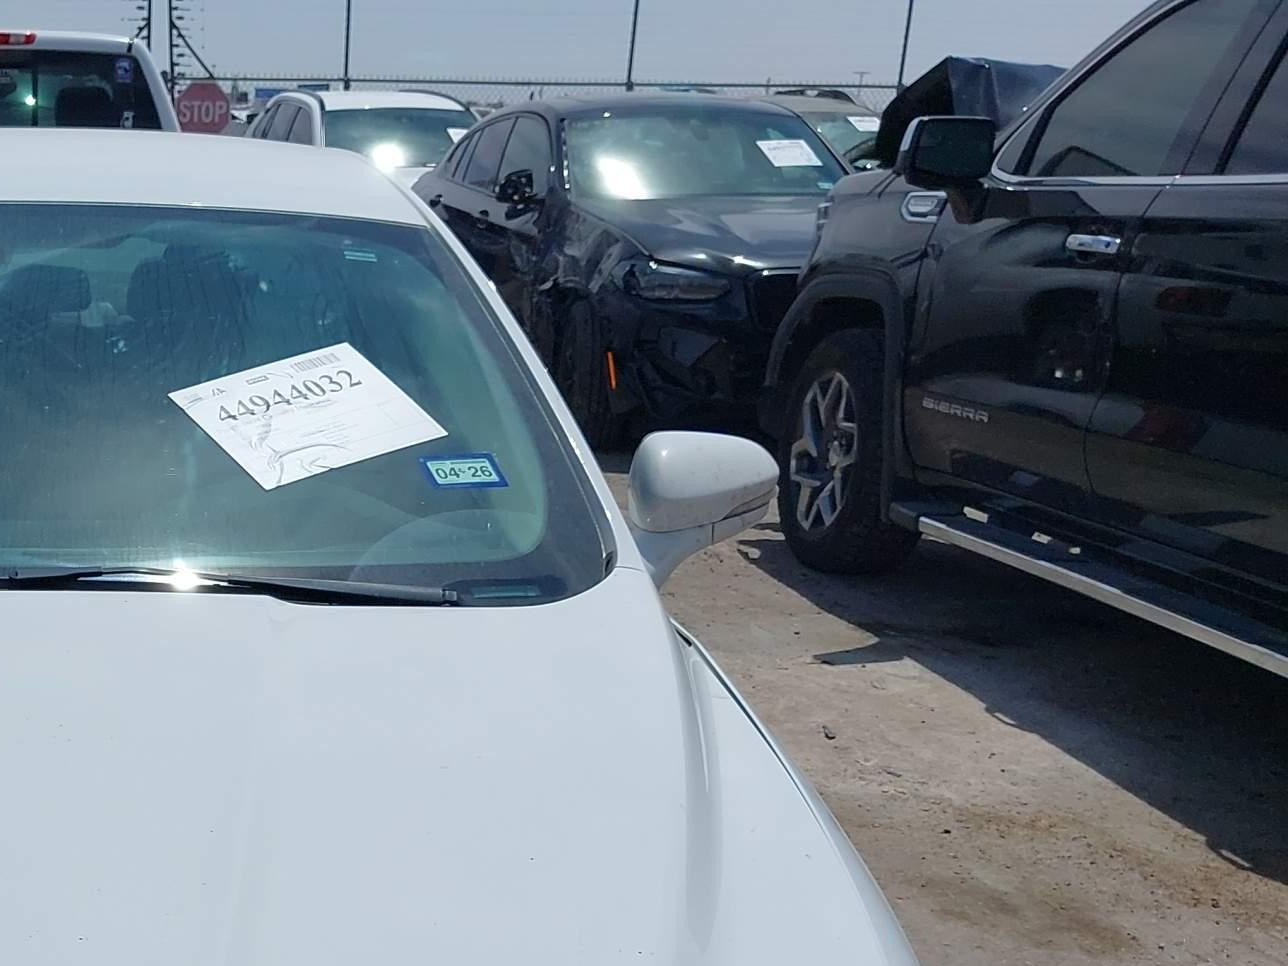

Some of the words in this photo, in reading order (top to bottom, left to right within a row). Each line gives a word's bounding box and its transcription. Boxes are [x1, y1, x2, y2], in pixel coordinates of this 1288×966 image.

[178, 101, 228, 123] STOP
[217, 369, 363, 423] 44944032
[922, 397, 989, 423] SIERRA
[434, 467, 461, 480] 04
[467, 465, 493, 478] 26
